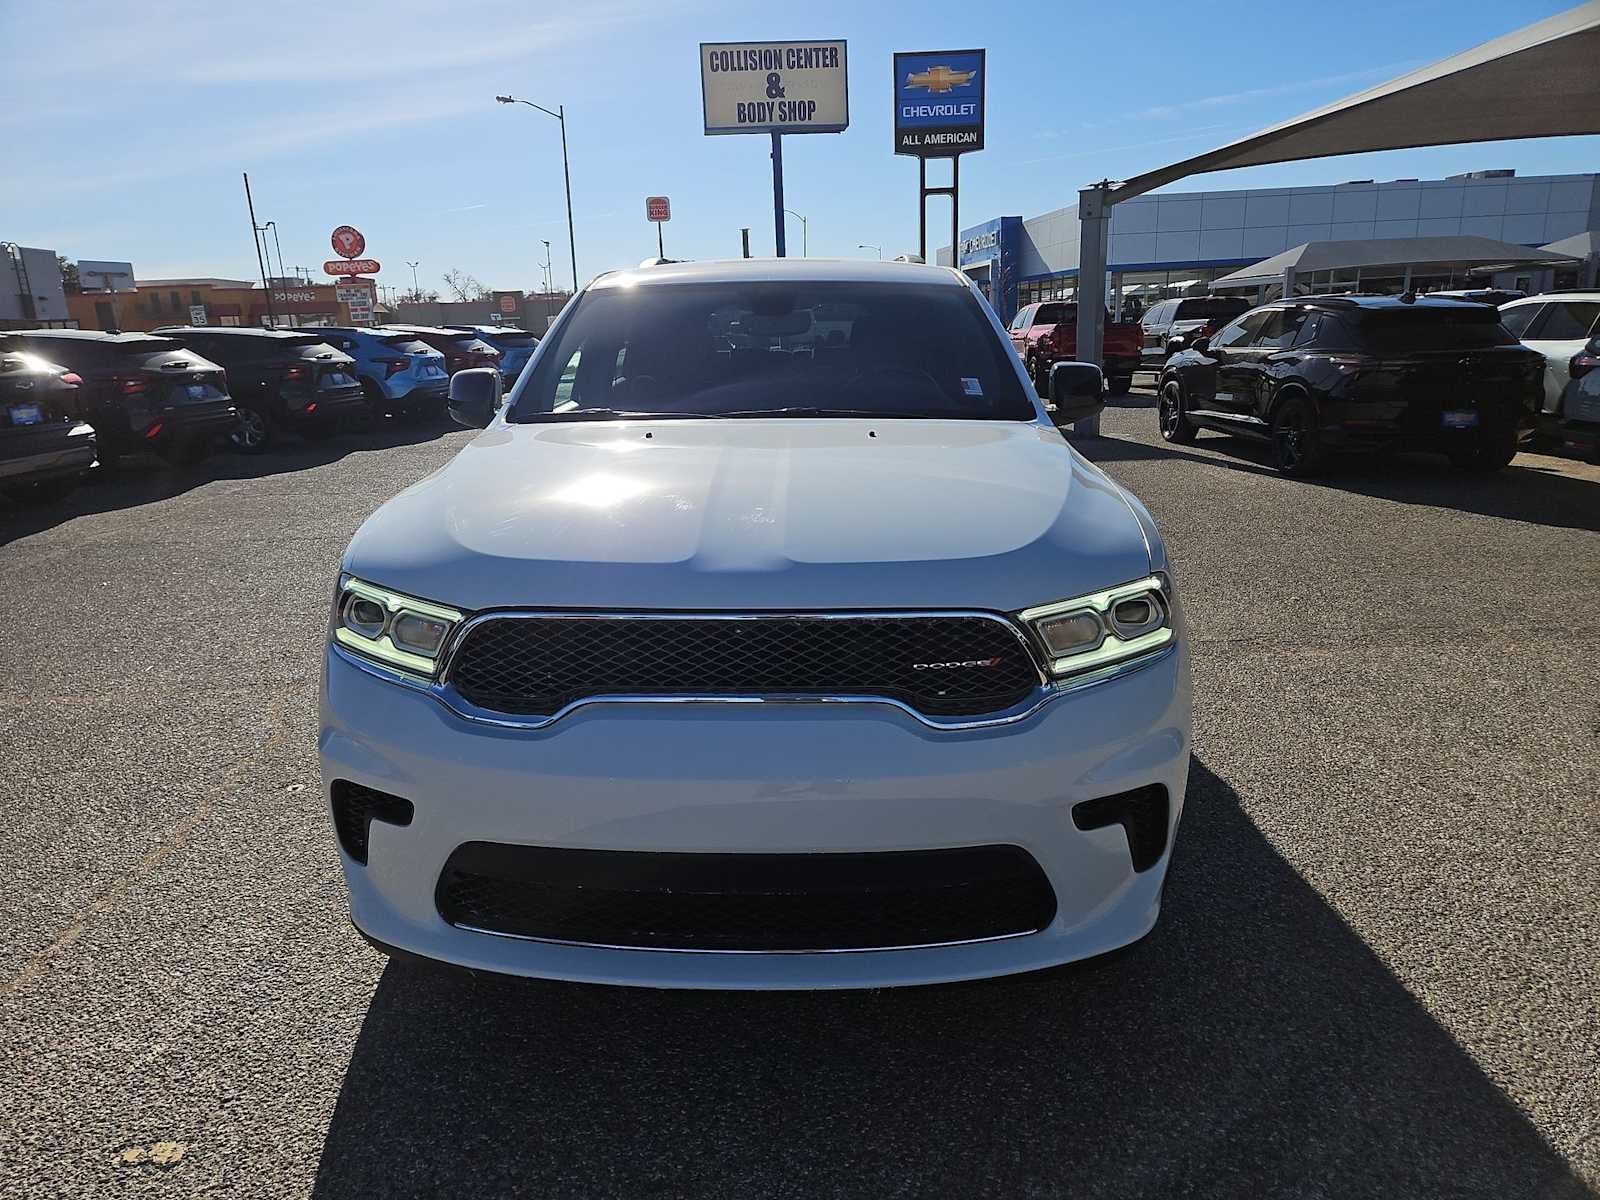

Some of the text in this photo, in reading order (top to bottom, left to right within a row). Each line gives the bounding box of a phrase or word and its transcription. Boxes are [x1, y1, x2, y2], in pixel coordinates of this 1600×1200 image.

[709, 47, 839, 73] COLLISION CENTER
[766, 72, 785, 99] &
[737, 100, 816, 123] BODY SHOP
[902, 103, 976, 118] CHEVROLET
[902, 132, 977, 146] ALL AMERICAN
[649, 209, 668, 217] KING
[913, 659, 992, 671] DODGE
